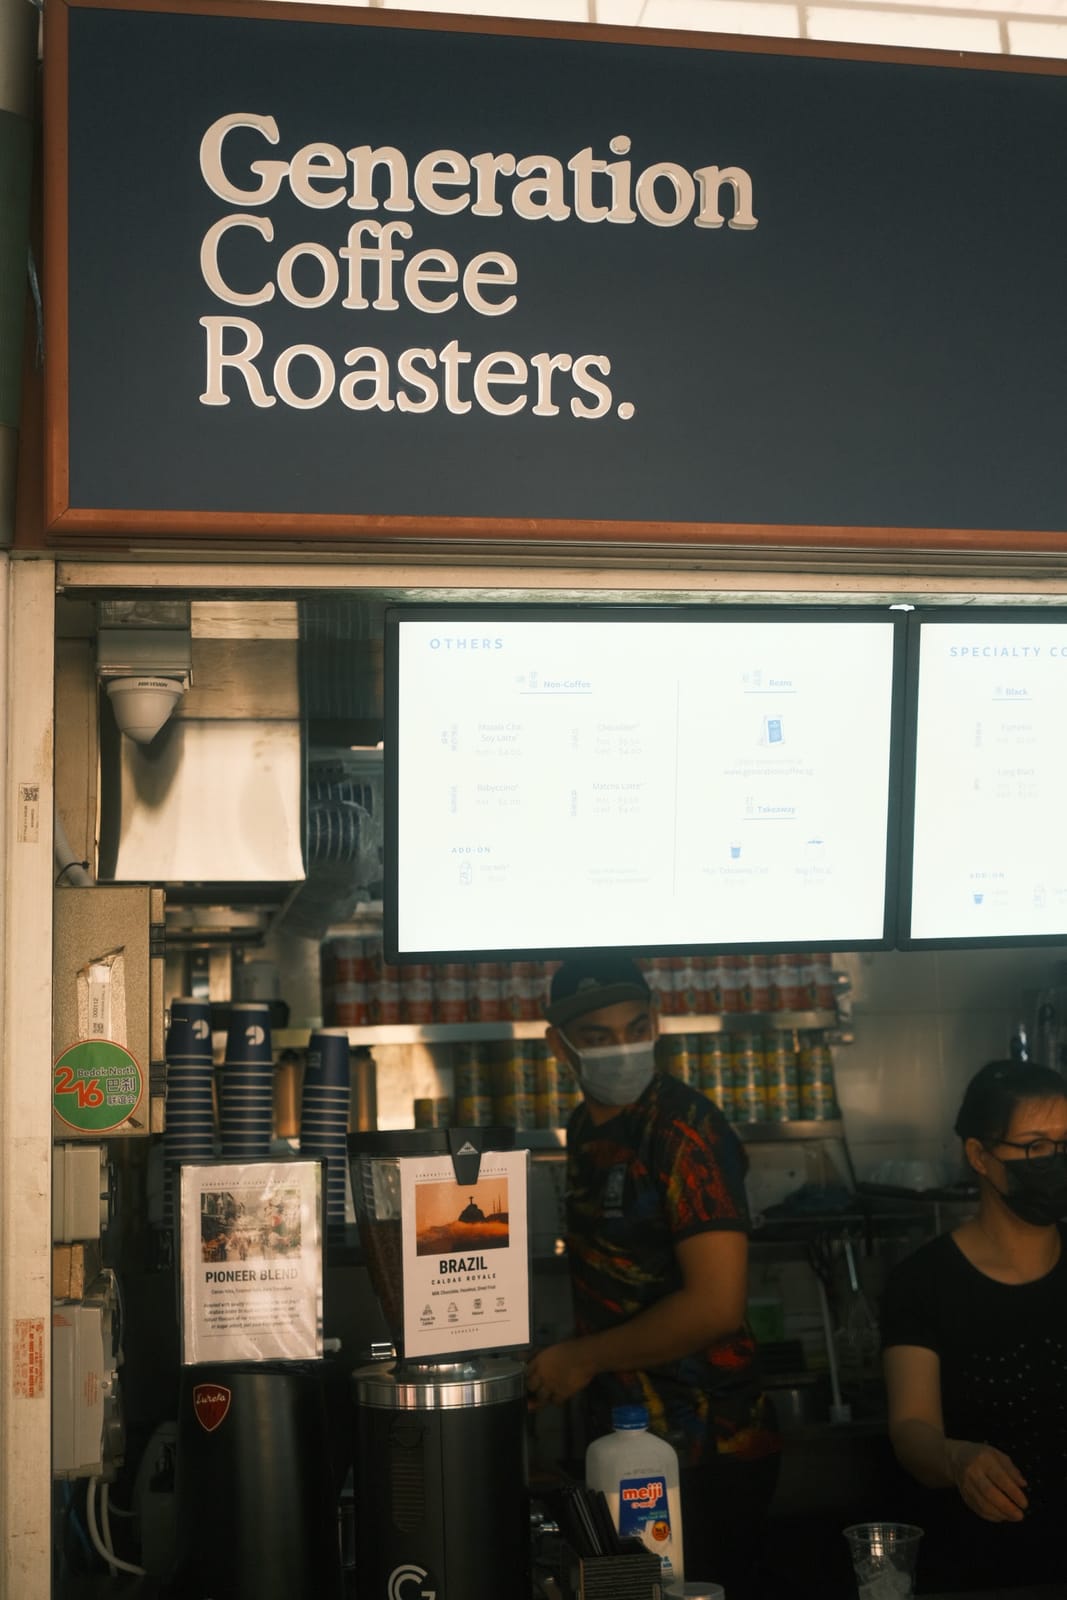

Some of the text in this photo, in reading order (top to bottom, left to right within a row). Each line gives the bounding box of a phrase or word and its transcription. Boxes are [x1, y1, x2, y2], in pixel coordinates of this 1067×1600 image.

[199, 112, 758, 230] Generation
[200, 214, 518, 315] Coffee
[199, 316, 635, 419] Roasters.
[430, 638, 504, 650] OTHERS
[950, 647, 1040, 657] SPECIALTY
[543, 681, 592, 689] Non-Coffee
[757, 806, 796, 814] Takeaway
[78, 1065, 135, 1078] Bedok North
[55, 1066, 104, 1108] 216
[106, 1078, 136, 1092] 巴刹
[440, 1256, 488, 1274] BRAZIL
[205, 1268, 298, 1283] PIONEER BLEND
[466, 1273, 496, 1282] ROYALE
[623, 1482, 662, 1502] meiji
